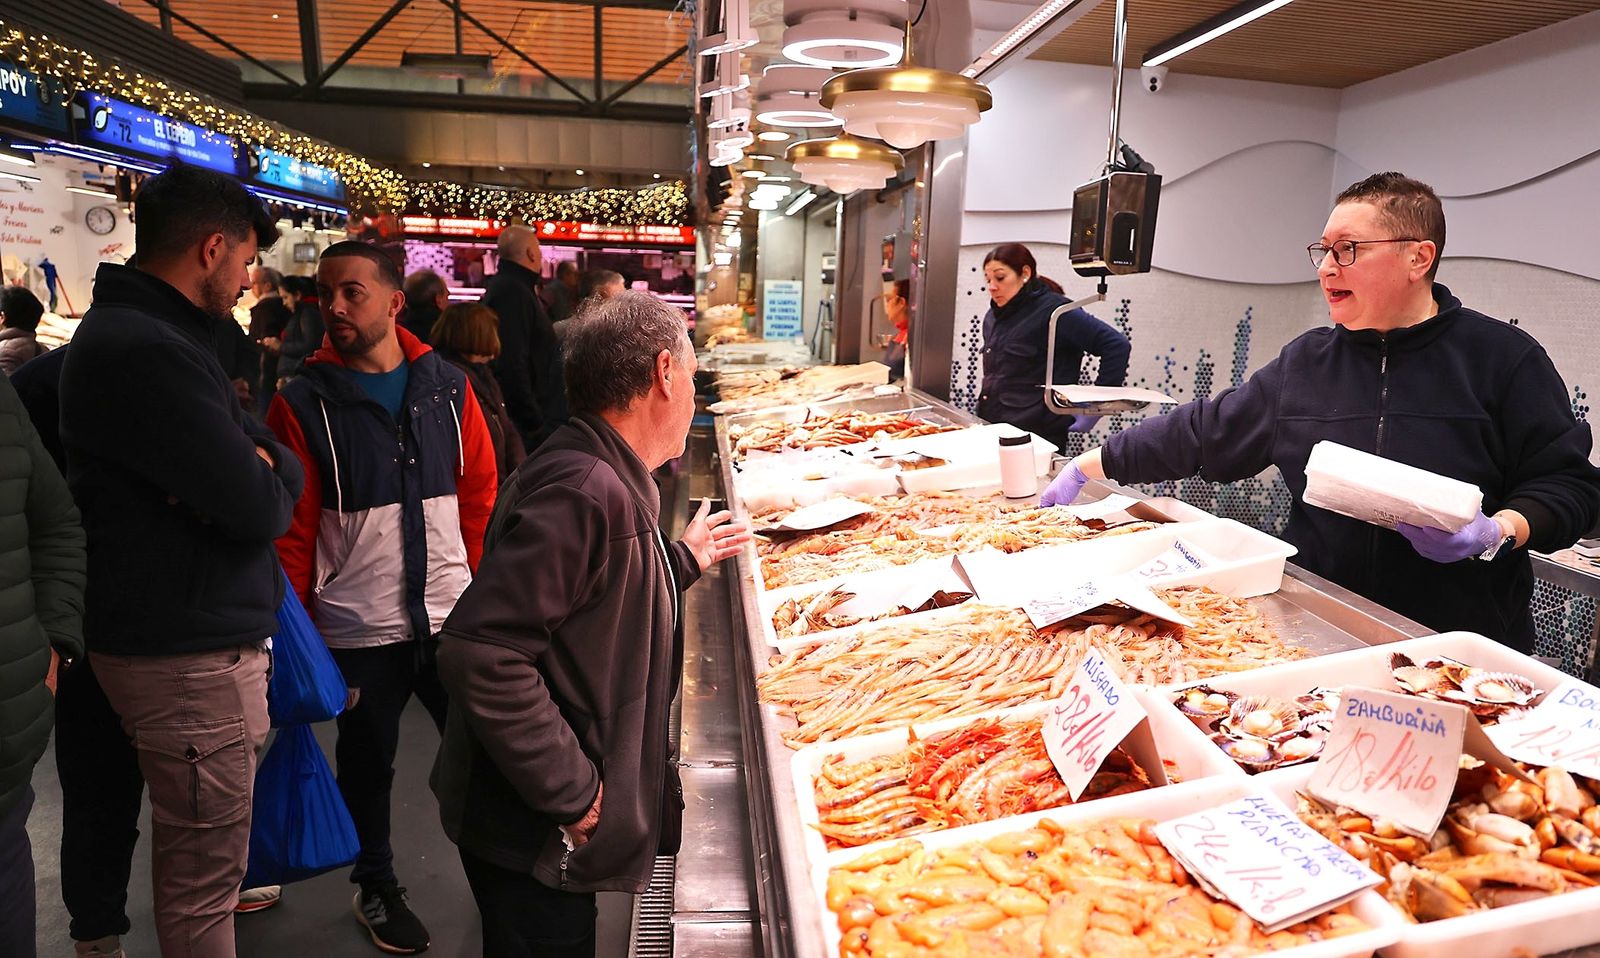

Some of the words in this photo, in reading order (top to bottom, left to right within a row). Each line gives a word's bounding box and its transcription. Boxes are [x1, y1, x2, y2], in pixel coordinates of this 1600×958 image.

[0, 68, 27, 97] POY
[119, 123, 133, 143] 72
[1082, 656, 1120, 706] ALISTADO
[1346, 698, 1447, 738] ZAMBURIÑA
